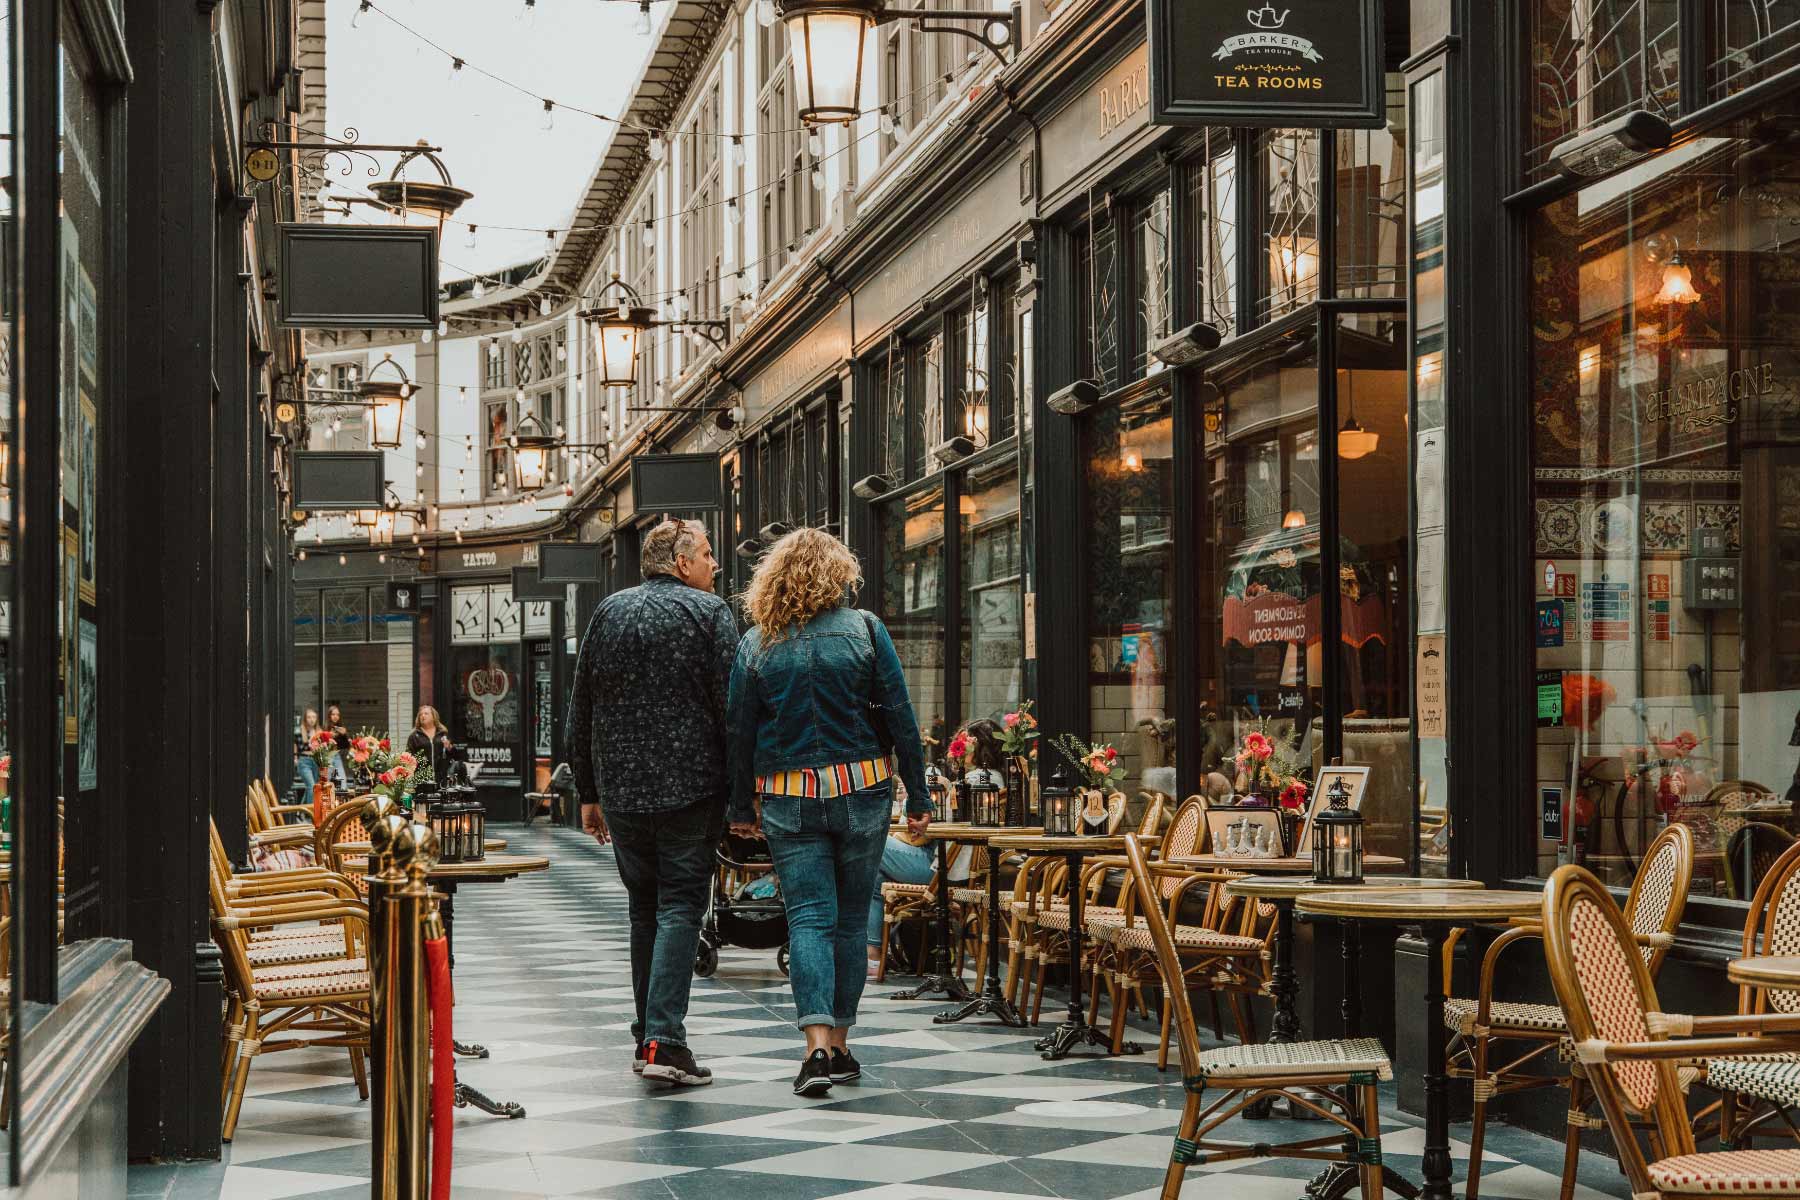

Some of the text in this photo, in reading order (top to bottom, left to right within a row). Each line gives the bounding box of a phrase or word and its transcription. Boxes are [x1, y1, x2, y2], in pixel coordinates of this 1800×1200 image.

[1238, 35, 1299, 48] BARKER
[1264, 48, 1292, 56] HOUSE
[1214, 76, 1322, 89] TEA ROOMS
[1645, 362, 1773, 424] CHAMPAGNE
[462, 552, 497, 567] TATTOO
[532, 601, 545, 617] 22
[467, 748, 512, 762] TATTOOS
